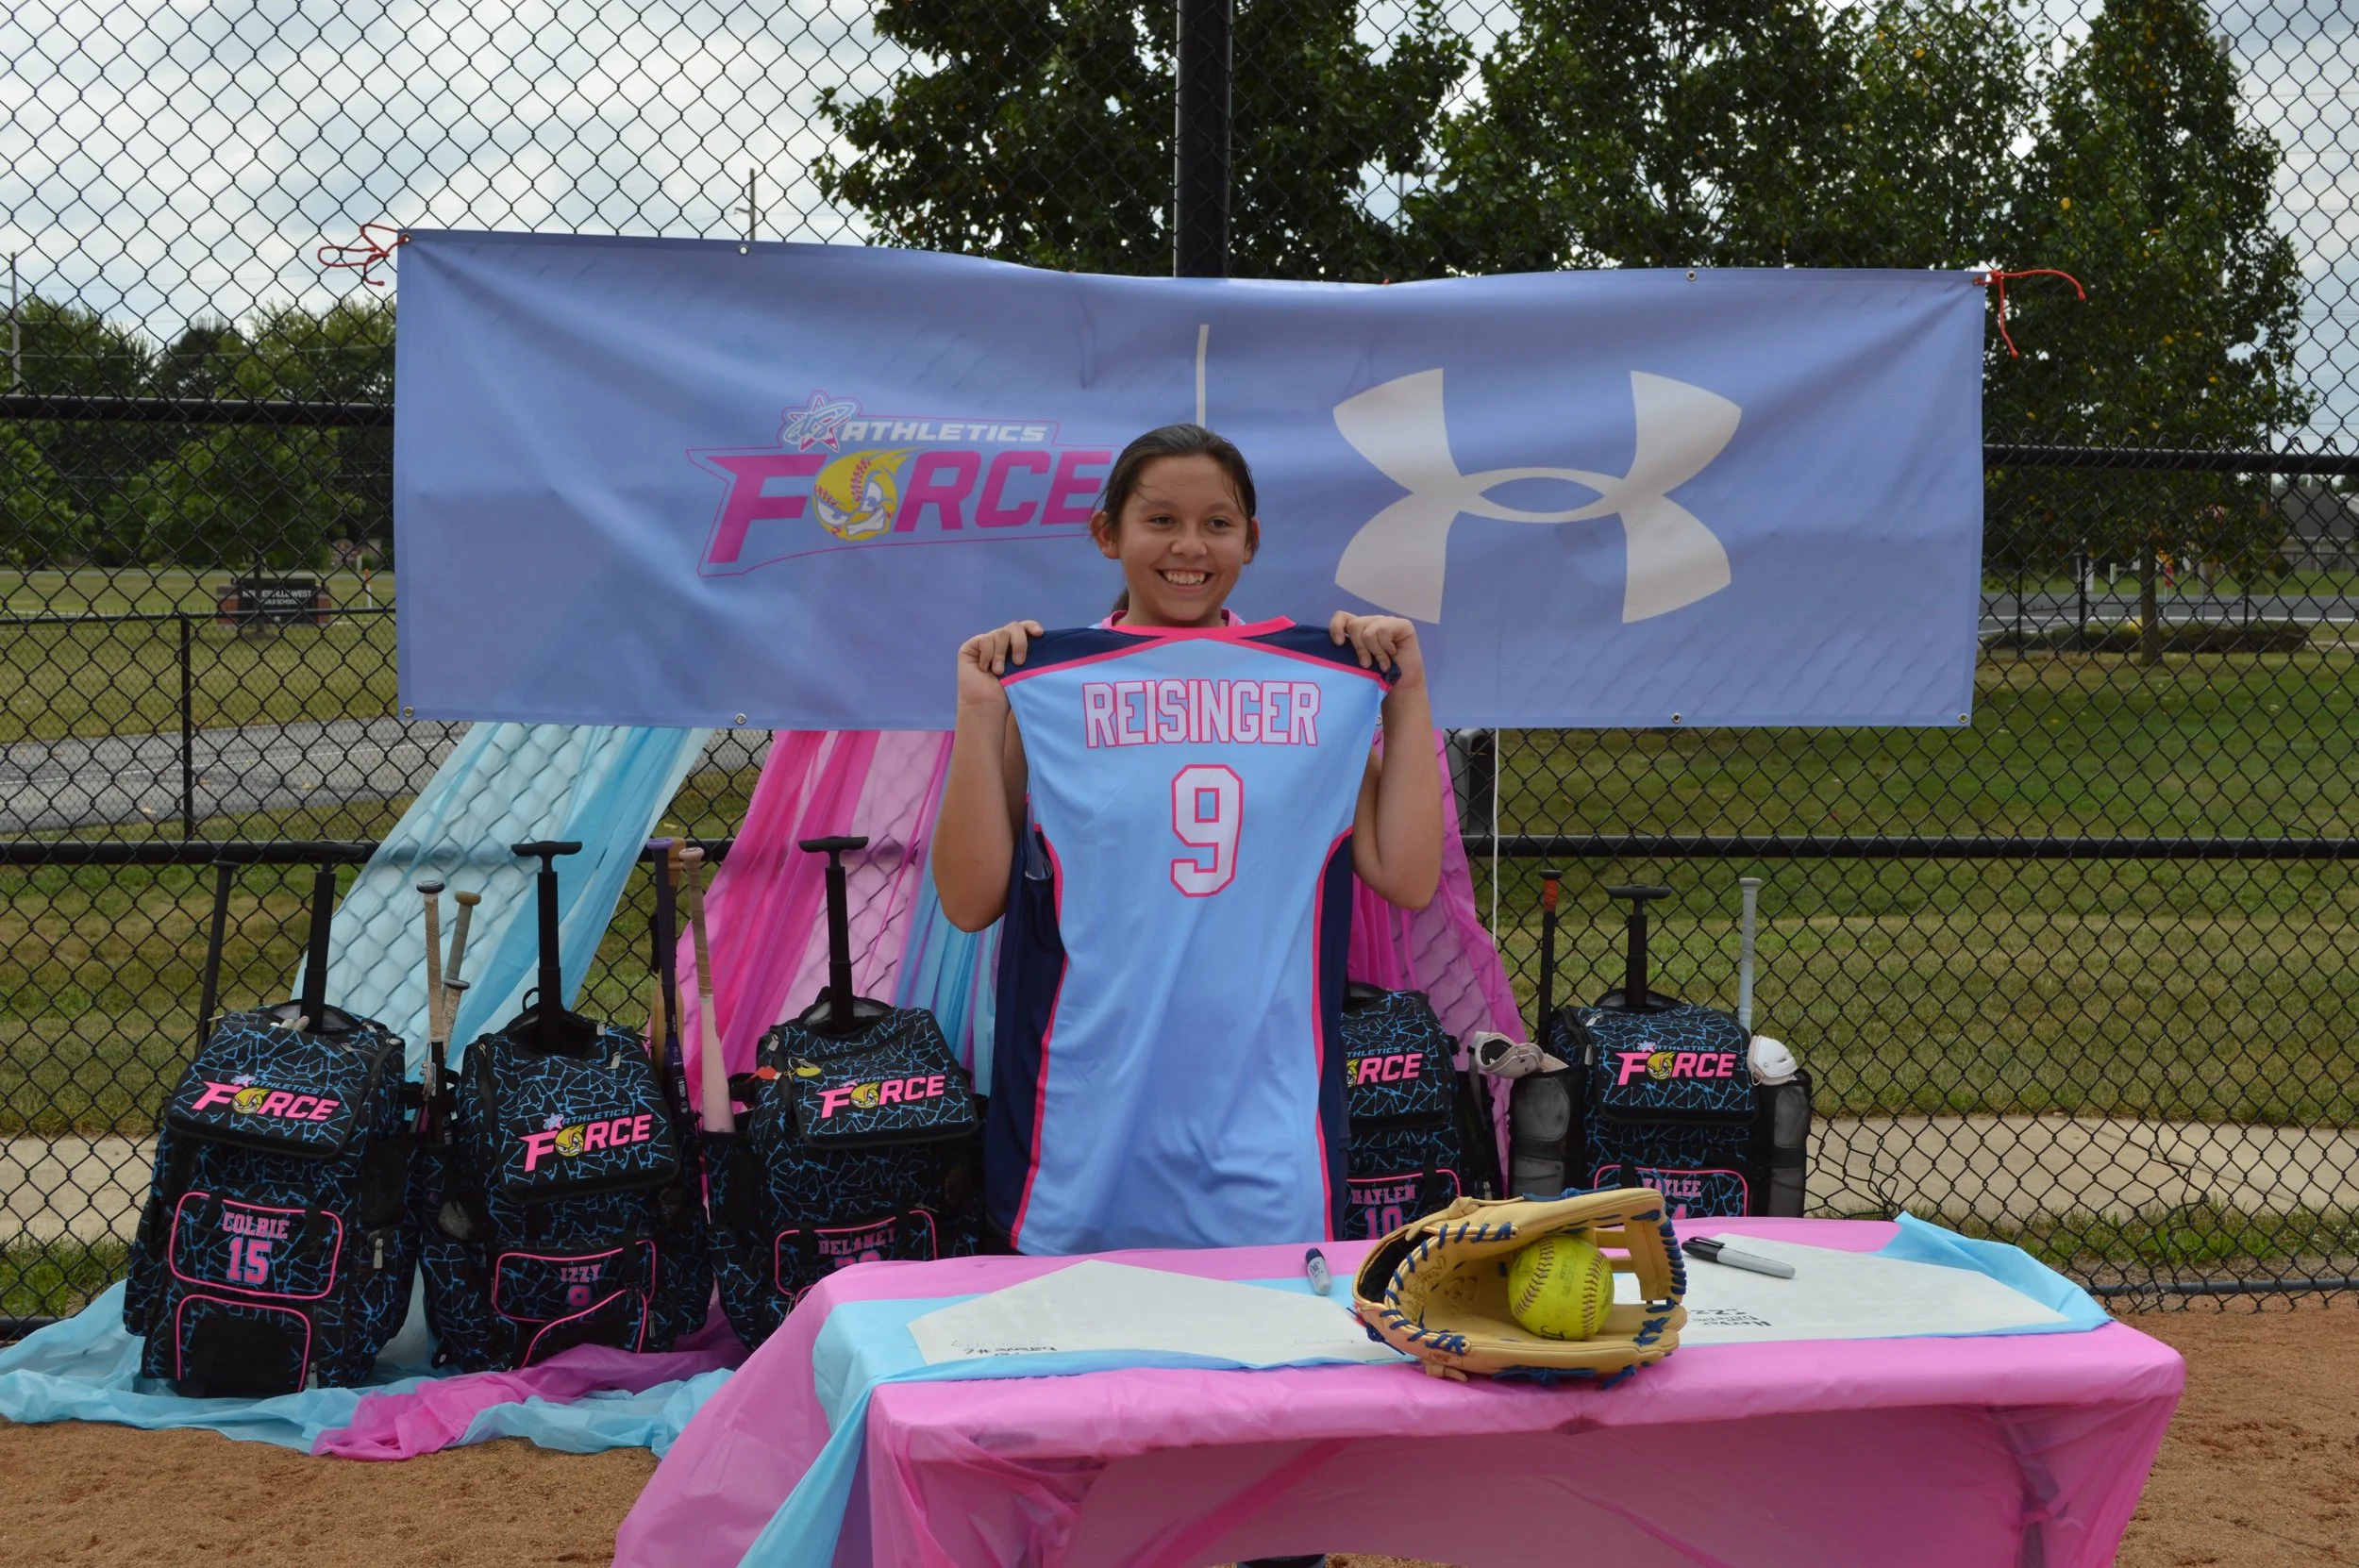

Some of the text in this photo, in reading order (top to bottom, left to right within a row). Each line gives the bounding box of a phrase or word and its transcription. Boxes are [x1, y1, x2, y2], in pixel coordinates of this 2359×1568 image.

[841, 421, 1047, 443] ATHLETICS
[706, 447, 1114, 563] FORCE
[291, 589, 312, 598] WEST
[1082, 679, 1321, 748] REISINGER
[1170, 764, 1244, 897] 9
[1347, 1046, 1401, 1059] THLETICS
[1614, 1051, 1737, 1086] FORCE
[192, 1080, 340, 1121] FORCE
[249, 1079, 322, 1094] ATHLETICS
[816, 1076, 945, 1119] FORCE
[562, 1108, 630, 1126] ATHLETICS
[519, 1114, 652, 1173] FORCE
[222, 1211, 291, 1239] COLBIE
[1364, 1206, 1403, 1240] 10
[818, 1227, 895, 1256] DELANEY
[226, 1238, 273, 1285] 15
[560, 1263, 602, 1283] IZZY
